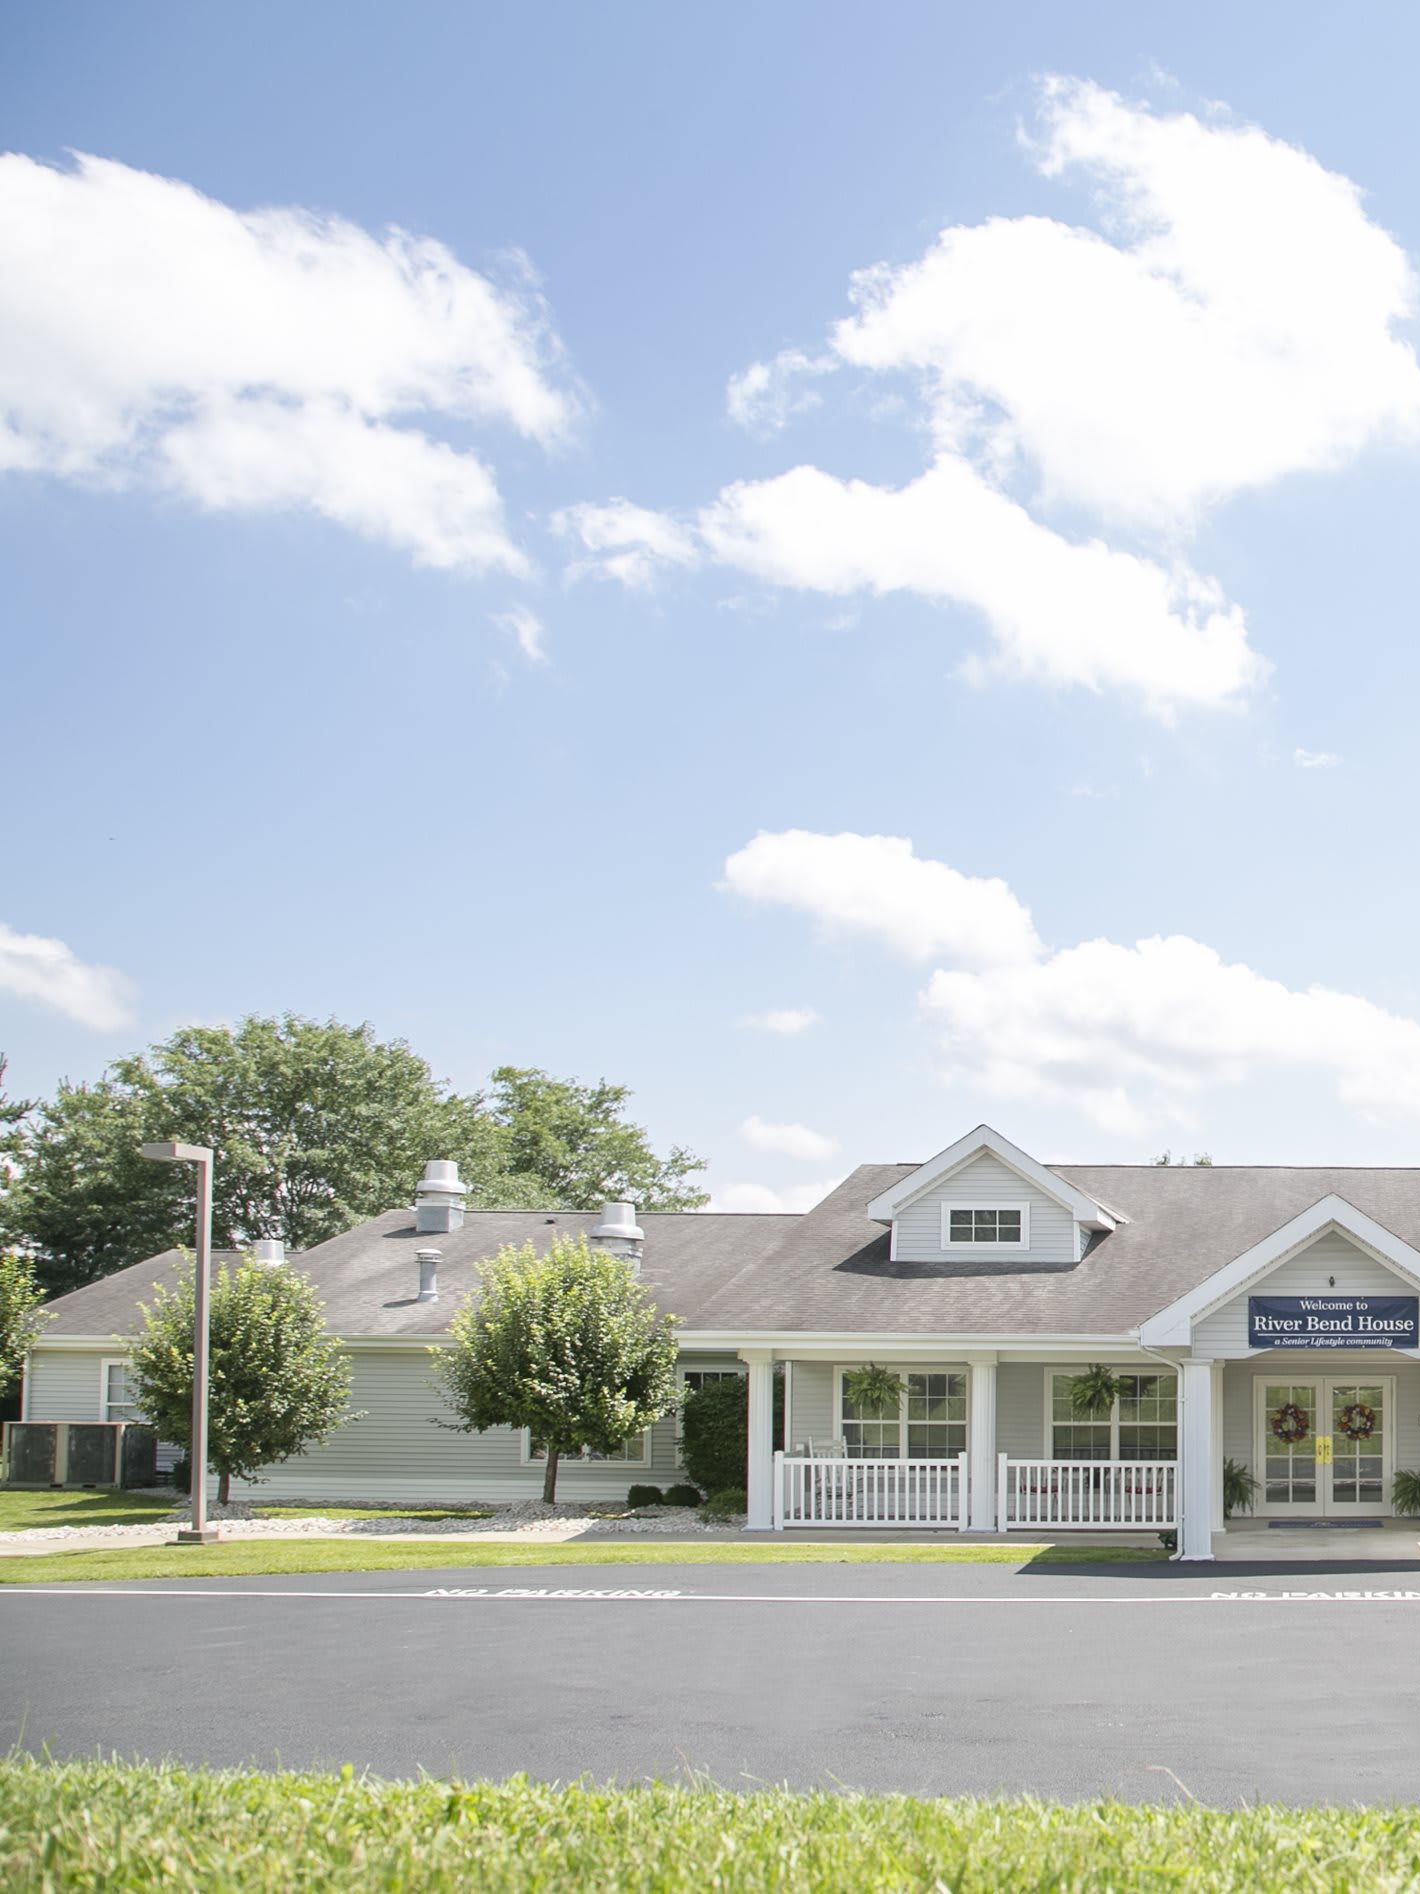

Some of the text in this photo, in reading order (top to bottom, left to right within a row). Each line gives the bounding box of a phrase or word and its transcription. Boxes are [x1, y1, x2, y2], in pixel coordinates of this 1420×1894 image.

[1300, 1300, 1369, 1311] Welcome to
[1254, 1316, 1414, 1331] River Bend House
[1282, 1337, 1310, 1345] Senior
[1310, 1337, 1345, 1347] Lifestyle
[1346, 1337, 1393, 1347] community
[496, 1589, 681, 1597] PARKING
